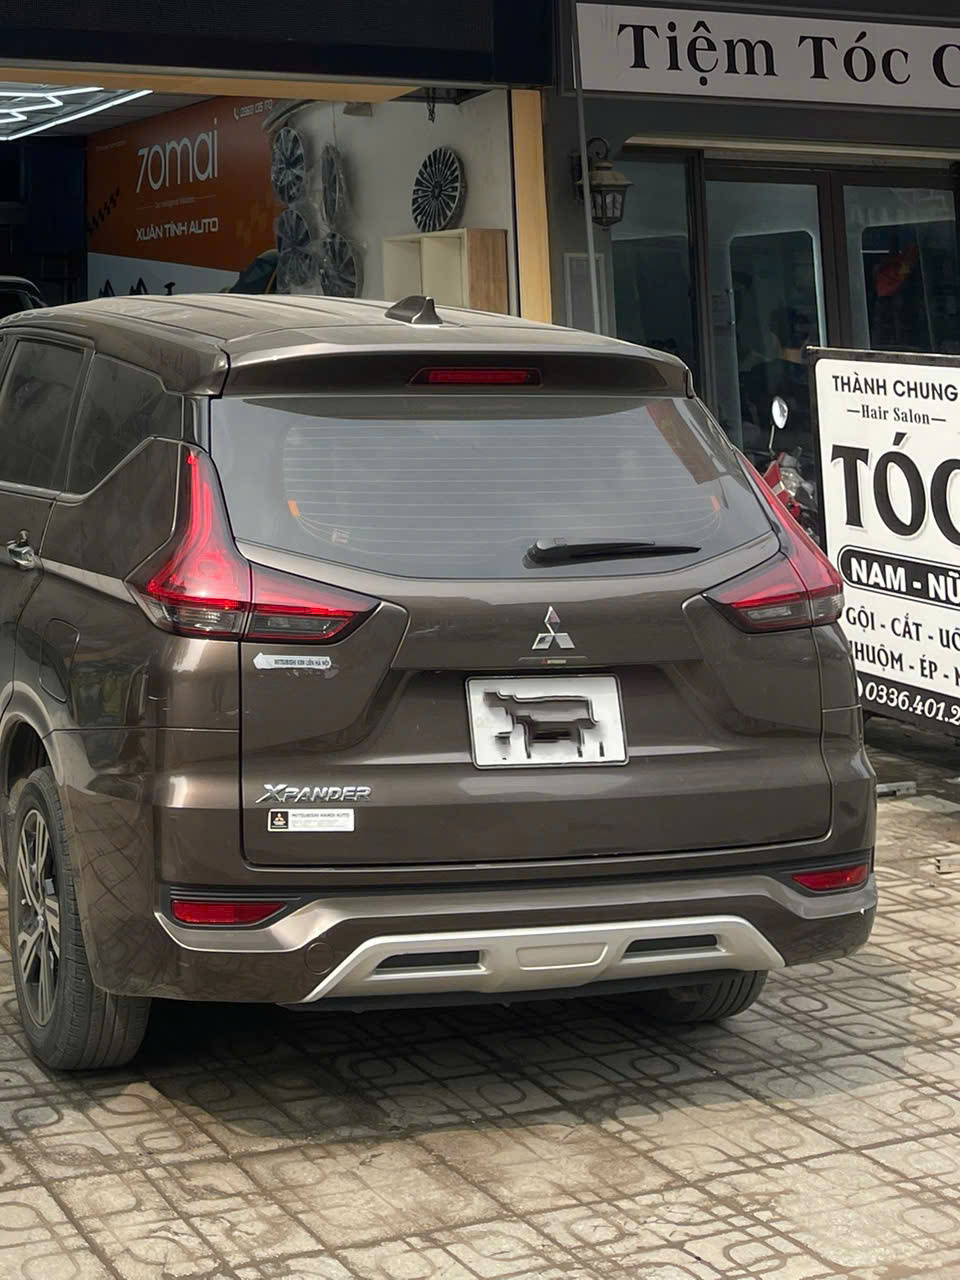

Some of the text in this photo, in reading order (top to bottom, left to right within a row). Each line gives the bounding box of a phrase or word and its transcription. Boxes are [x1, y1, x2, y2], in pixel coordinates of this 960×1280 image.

[617, 21, 779, 87] Tiệm
[798, 31, 912, 86] Tóc
[136, 118, 219, 194] 70mai
[188, 216, 219, 236] AUTO
[831, 372, 959, 402] THÀNH CHUNG
[850, 556, 907, 593] NAM
[845, 605, 876, 632] GỘI
[890, 613, 923, 641] CẮT
[919, 654, 939, 680] ÉP
[255, 783, 372, 804] XPANDER
